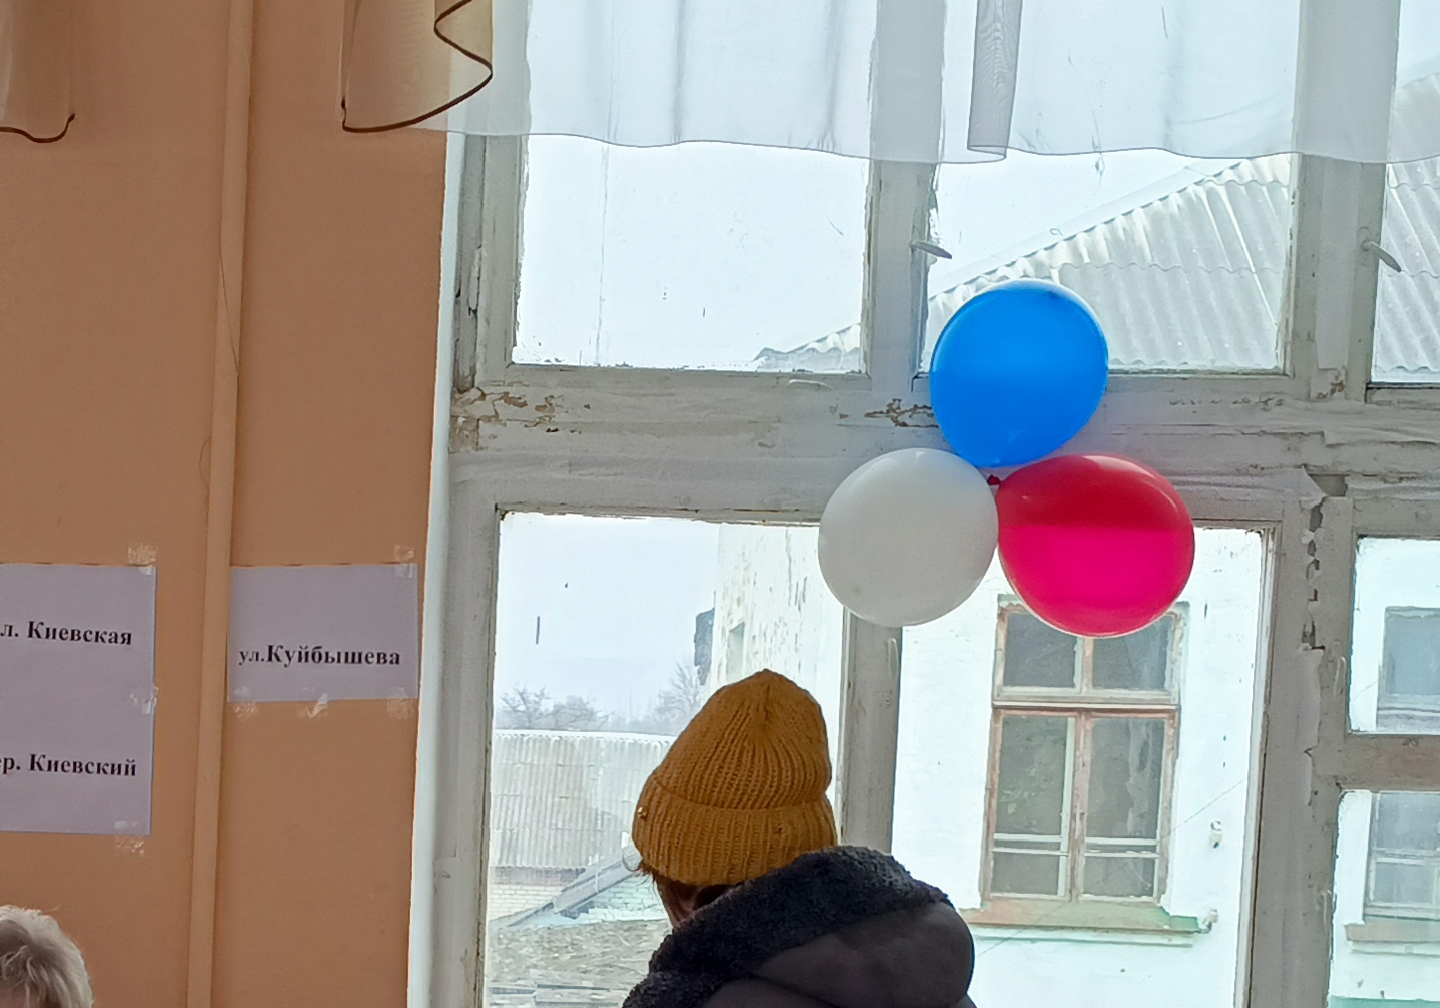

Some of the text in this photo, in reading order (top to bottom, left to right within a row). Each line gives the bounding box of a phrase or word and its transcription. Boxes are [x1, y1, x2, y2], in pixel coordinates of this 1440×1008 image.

[27, 620, 133, 646] Киевская
[238, 644, 401, 668] ул.Куйбышева
[28, 752, 137, 778] Киевский
